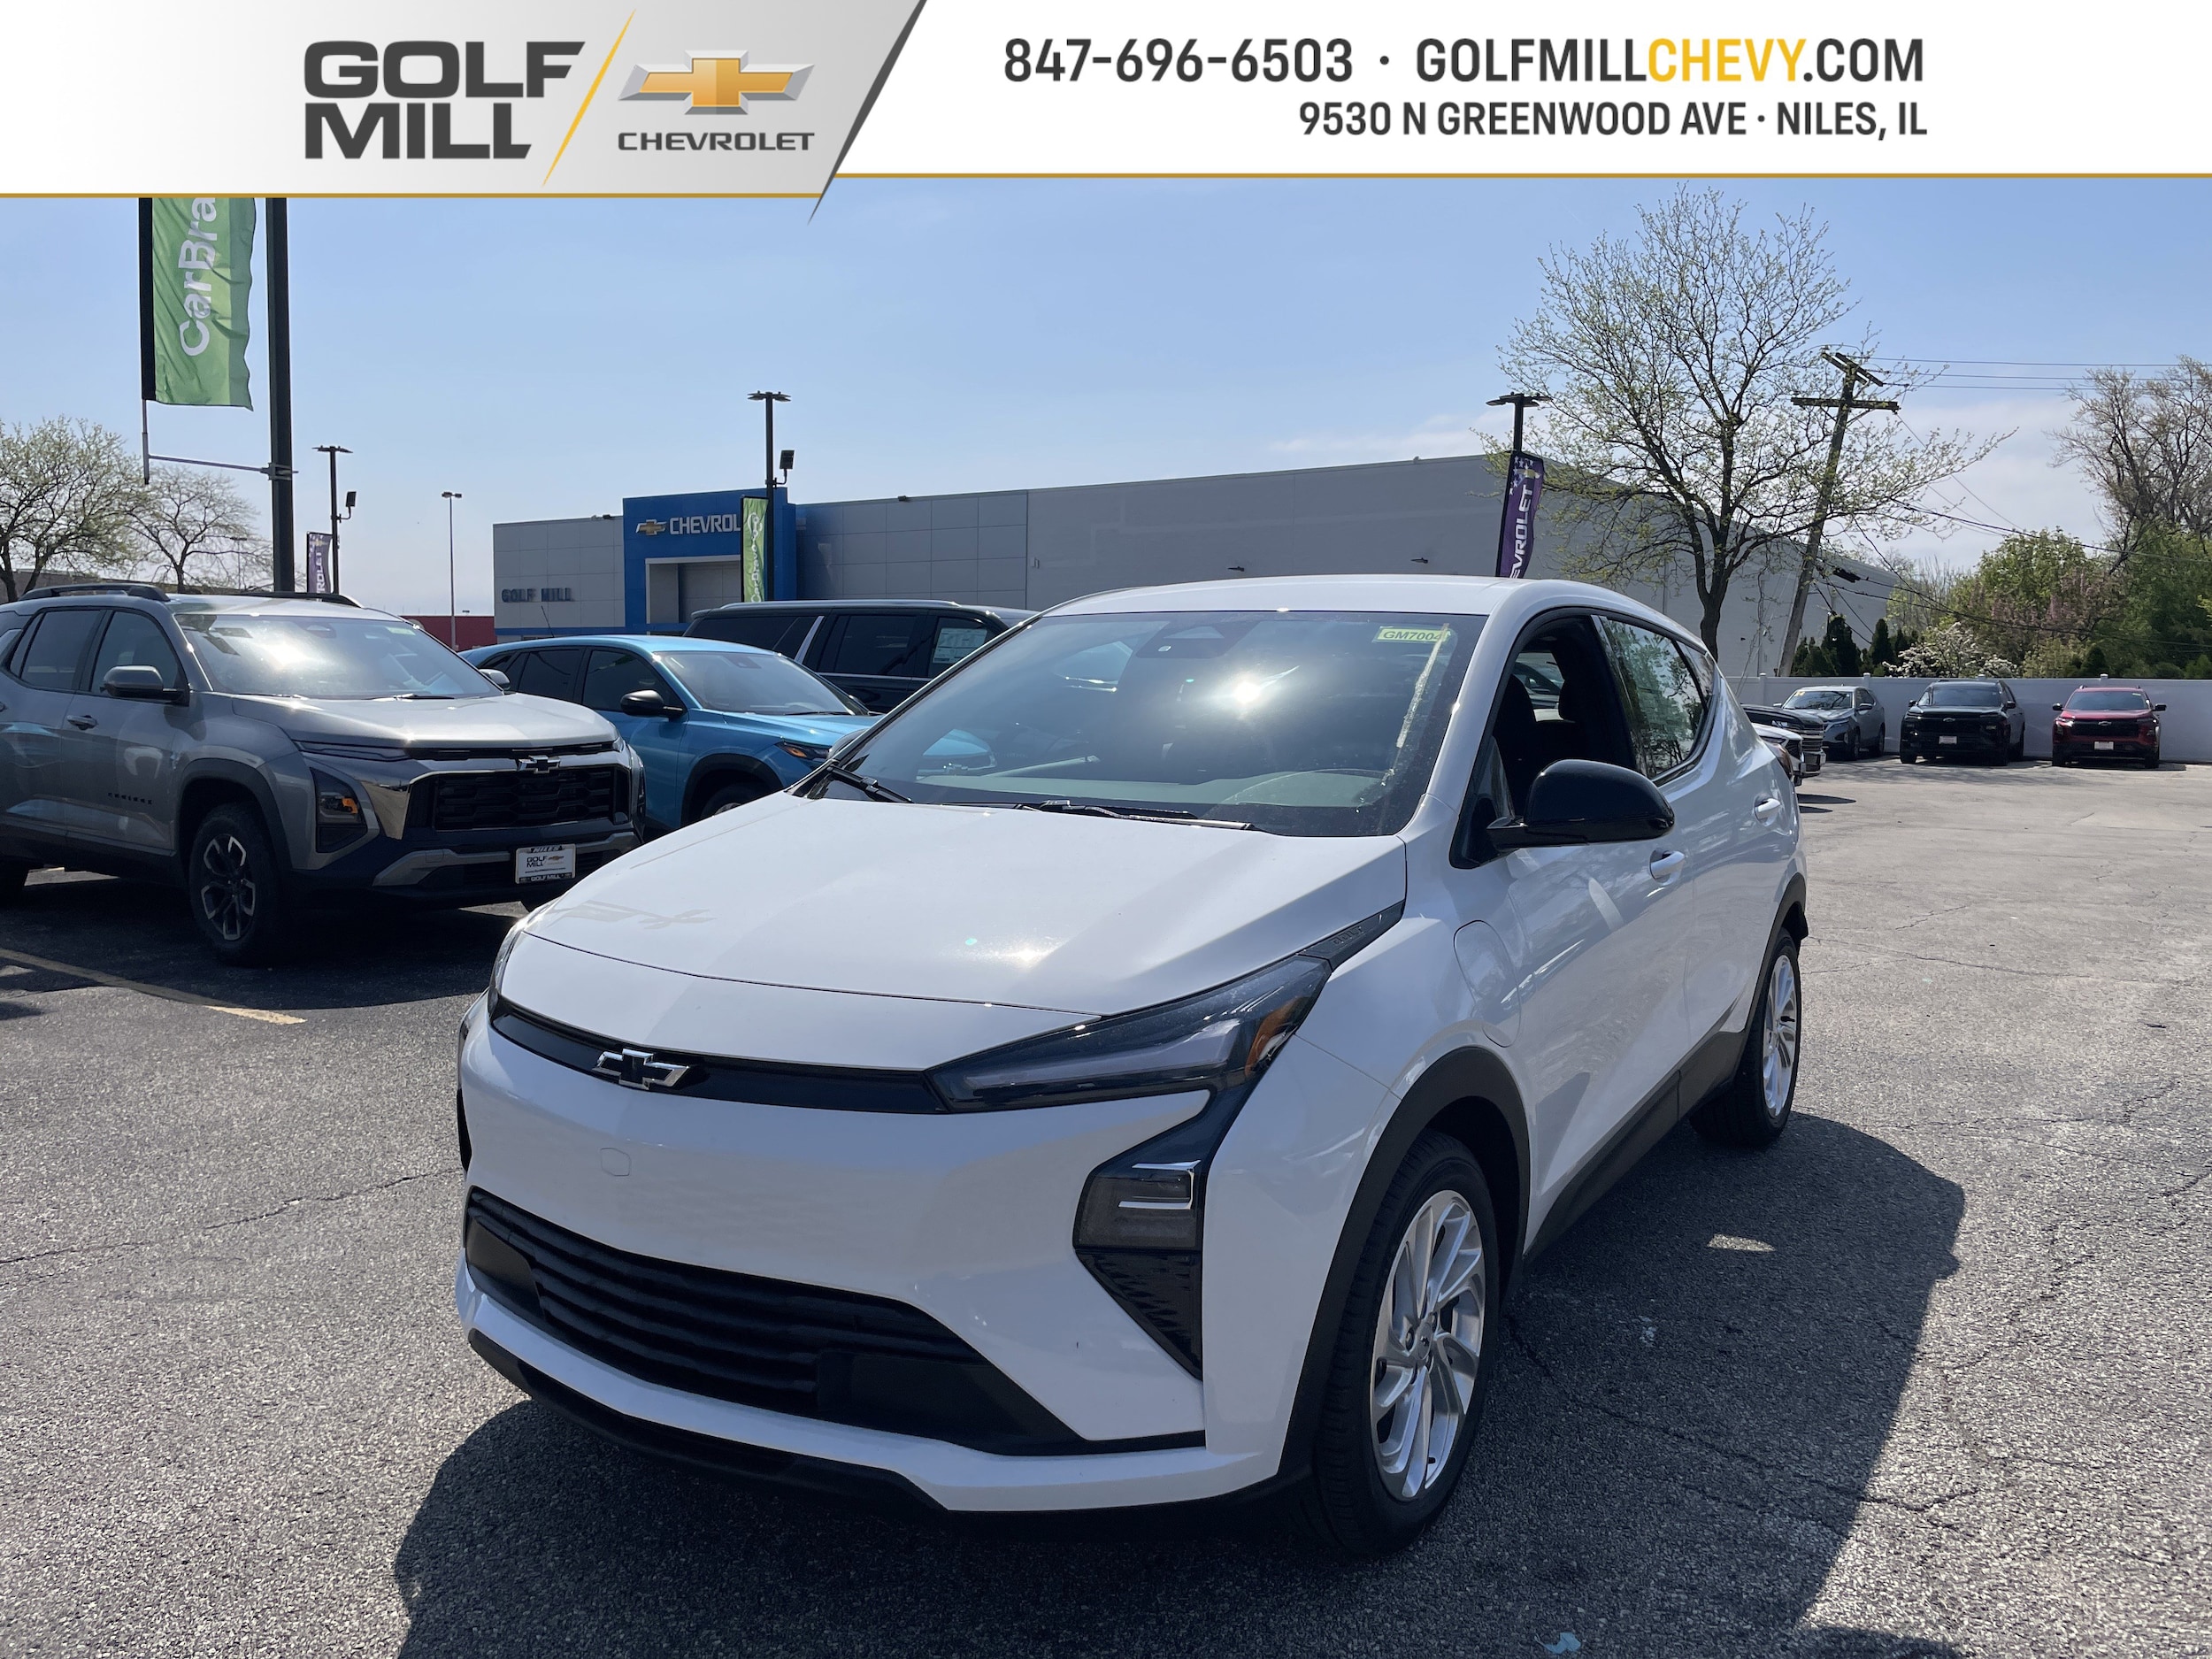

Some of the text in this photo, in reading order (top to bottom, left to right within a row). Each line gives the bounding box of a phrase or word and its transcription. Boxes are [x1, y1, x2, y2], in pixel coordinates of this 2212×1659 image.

[316, 551, 326, 593] ROLET
[502, 588, 574, 603] GOLF MILL
